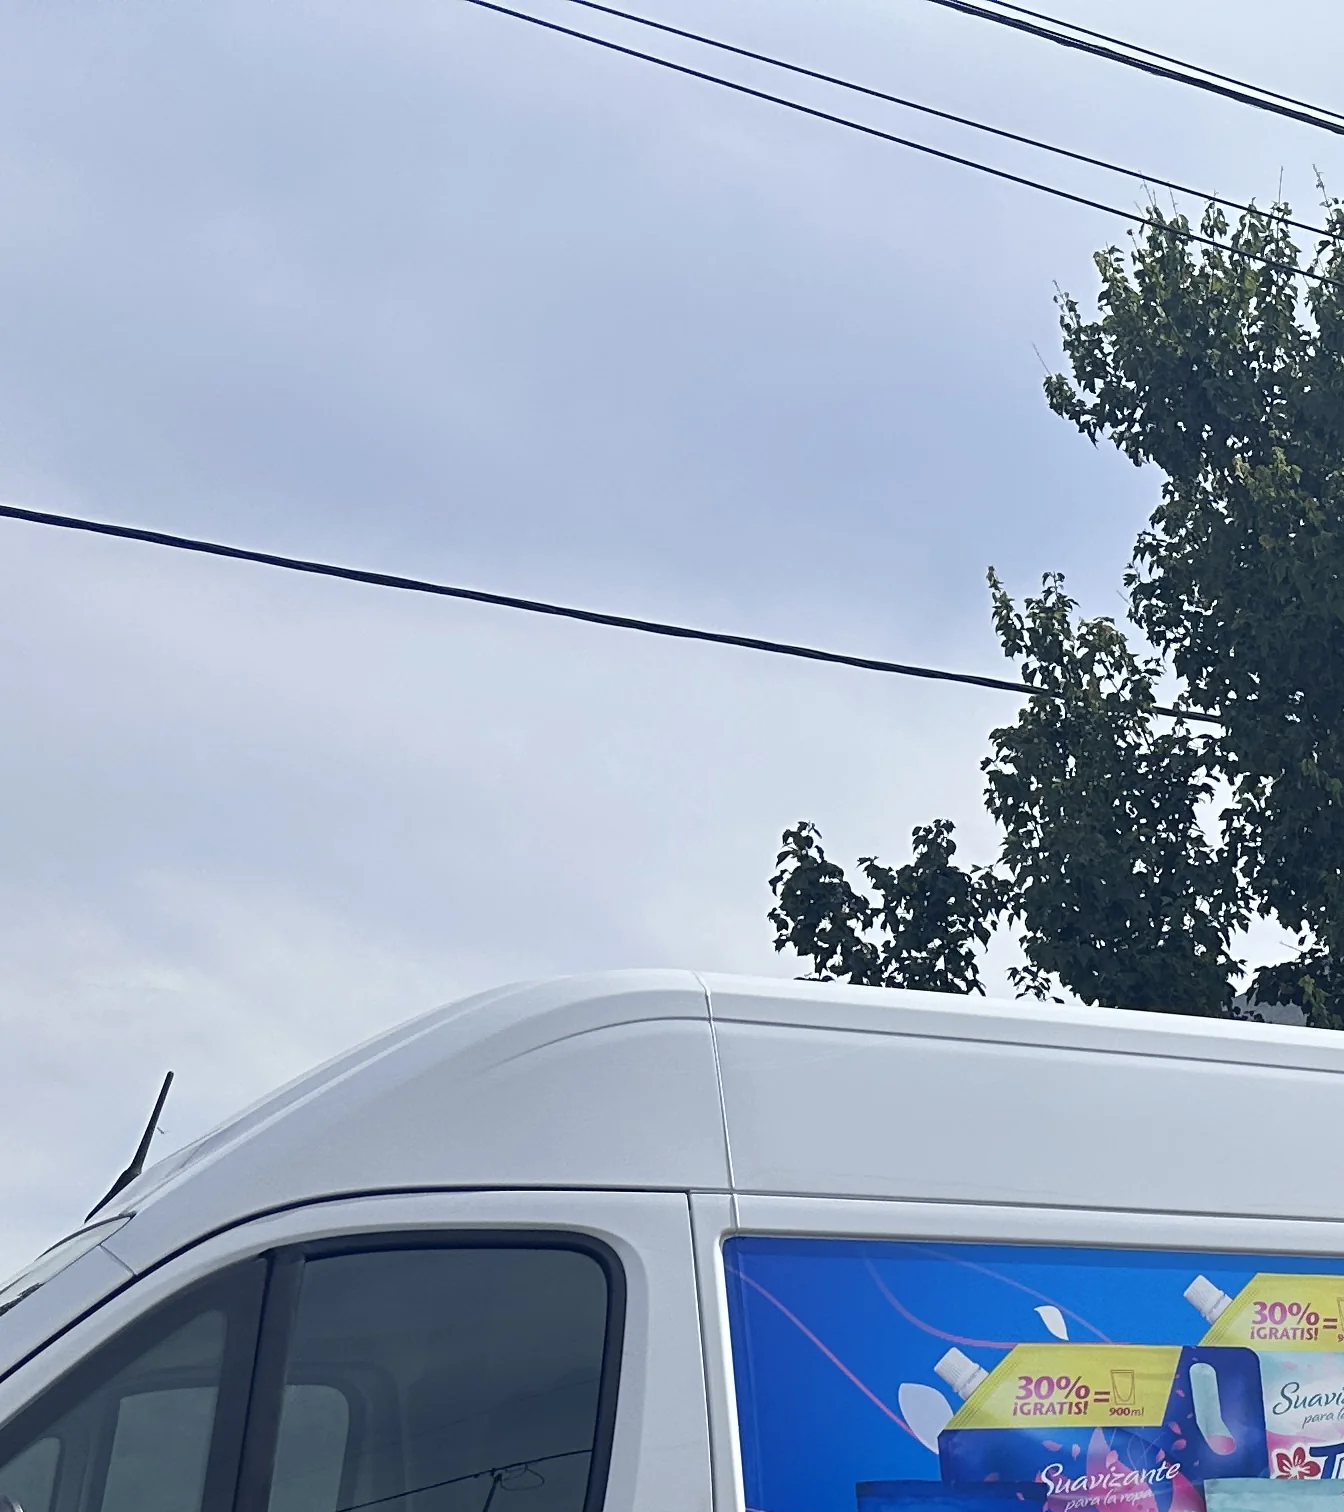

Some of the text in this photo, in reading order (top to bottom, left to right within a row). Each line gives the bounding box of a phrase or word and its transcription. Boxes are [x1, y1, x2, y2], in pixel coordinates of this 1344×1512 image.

[1252, 1301, 1320, 1326] 30%
[1250, 1327, 1319, 1341] ¡GRATIS!
[1016, 1375, 1090, 1400] 30%
[1012, 1401, 1089, 1416] ¡GRATIS!
[1302, 1411, 1334, 1429] para
[1041, 1460, 1181, 1496] Suavizante
[1103, 1489, 1118, 1505] la
[1120, 1490, 1153, 1506] ropa
